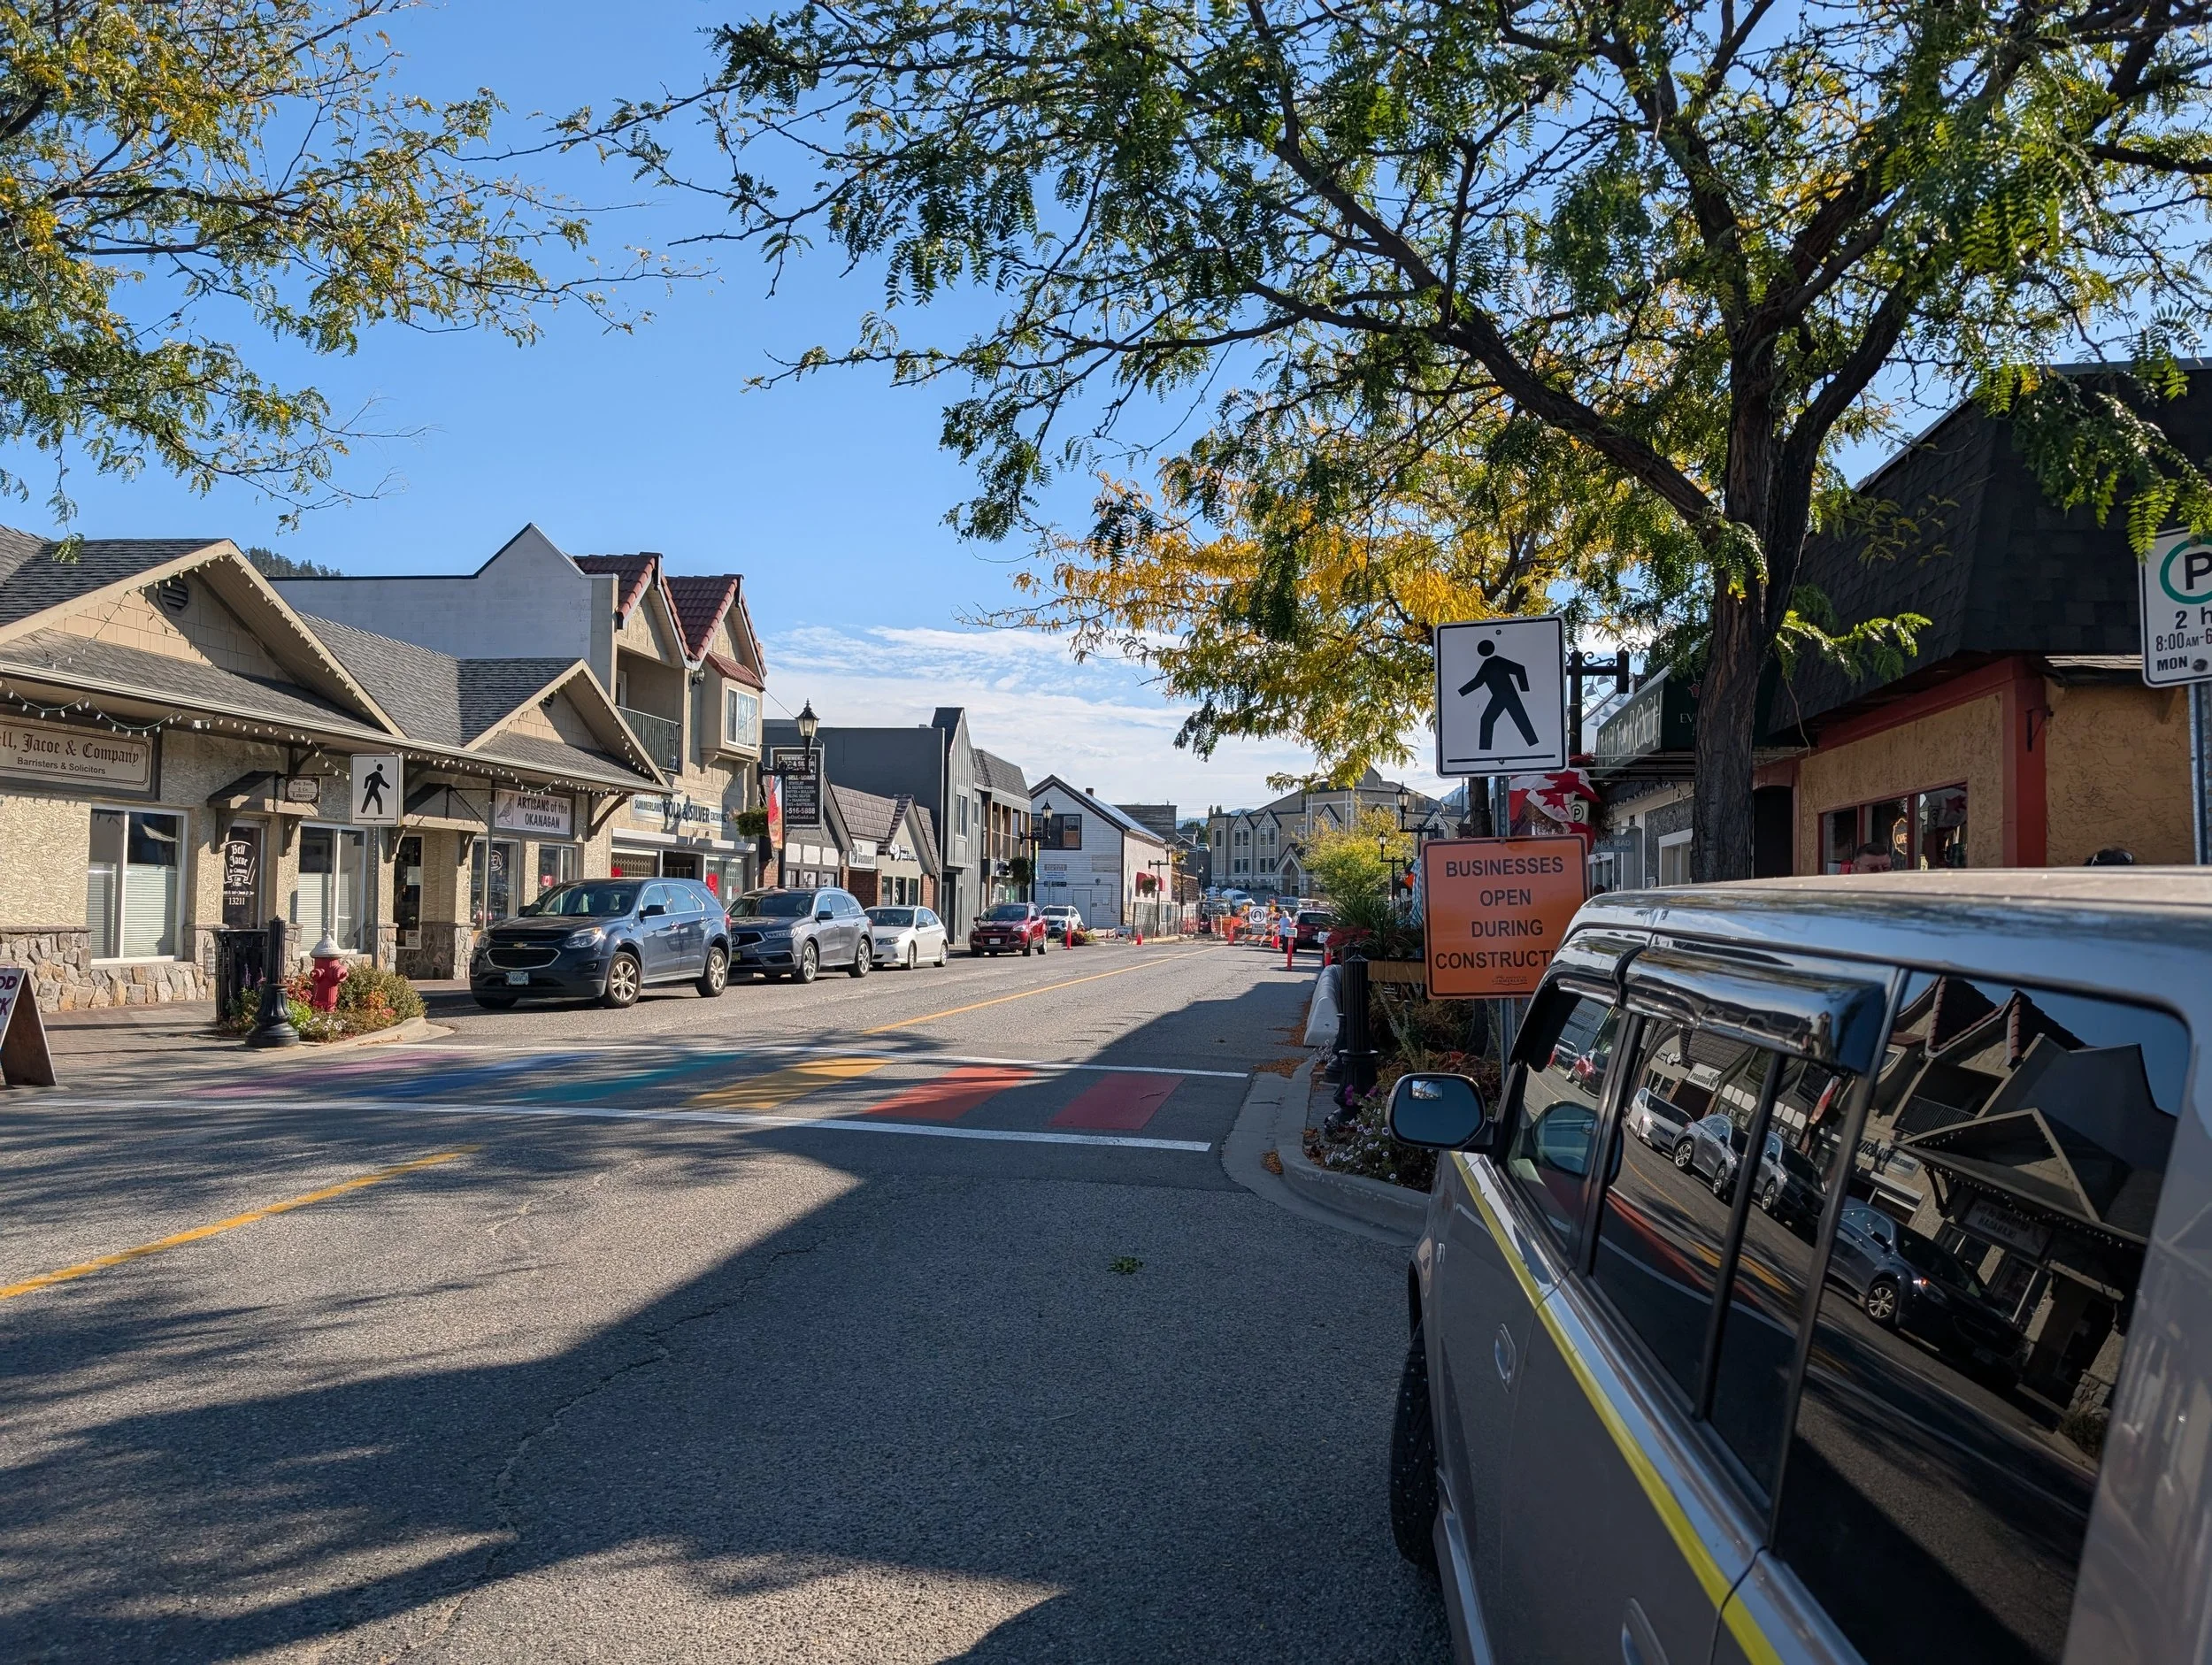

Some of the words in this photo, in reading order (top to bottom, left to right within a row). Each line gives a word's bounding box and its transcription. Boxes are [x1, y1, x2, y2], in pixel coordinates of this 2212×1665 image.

[2175, 610, 2187, 630] 2
[2200, 607, 2212, 625] h
[2156, 656, 2188, 671] MON
[21, 733, 60, 754] Jacoe
[65, 740, 77, 756] &
[82, 742, 139, 767] Company
[17, 756, 58, 770] Barristers
[69, 763, 106, 774] Solicitors
[517, 796, 549, 813] ARTISANS
[550, 802, 557, 813] of
[558, 802, 568, 814] the
[634, 799, 662, 813] SUMMERLAND
[662, 799, 681, 819] GOLD
[689, 804, 710, 823] SILVER
[525, 813, 560, 829] OKANAGAN
[231, 844, 246, 855] Bell
[229, 855, 248, 867] Jacoe
[1446, 856, 1564, 878] BUSINESSES
[1479, 888, 1532, 907] OPEN
[1471, 918, 1543, 938] DURING
[1435, 949, 1555, 970] CONSTRUCTI
